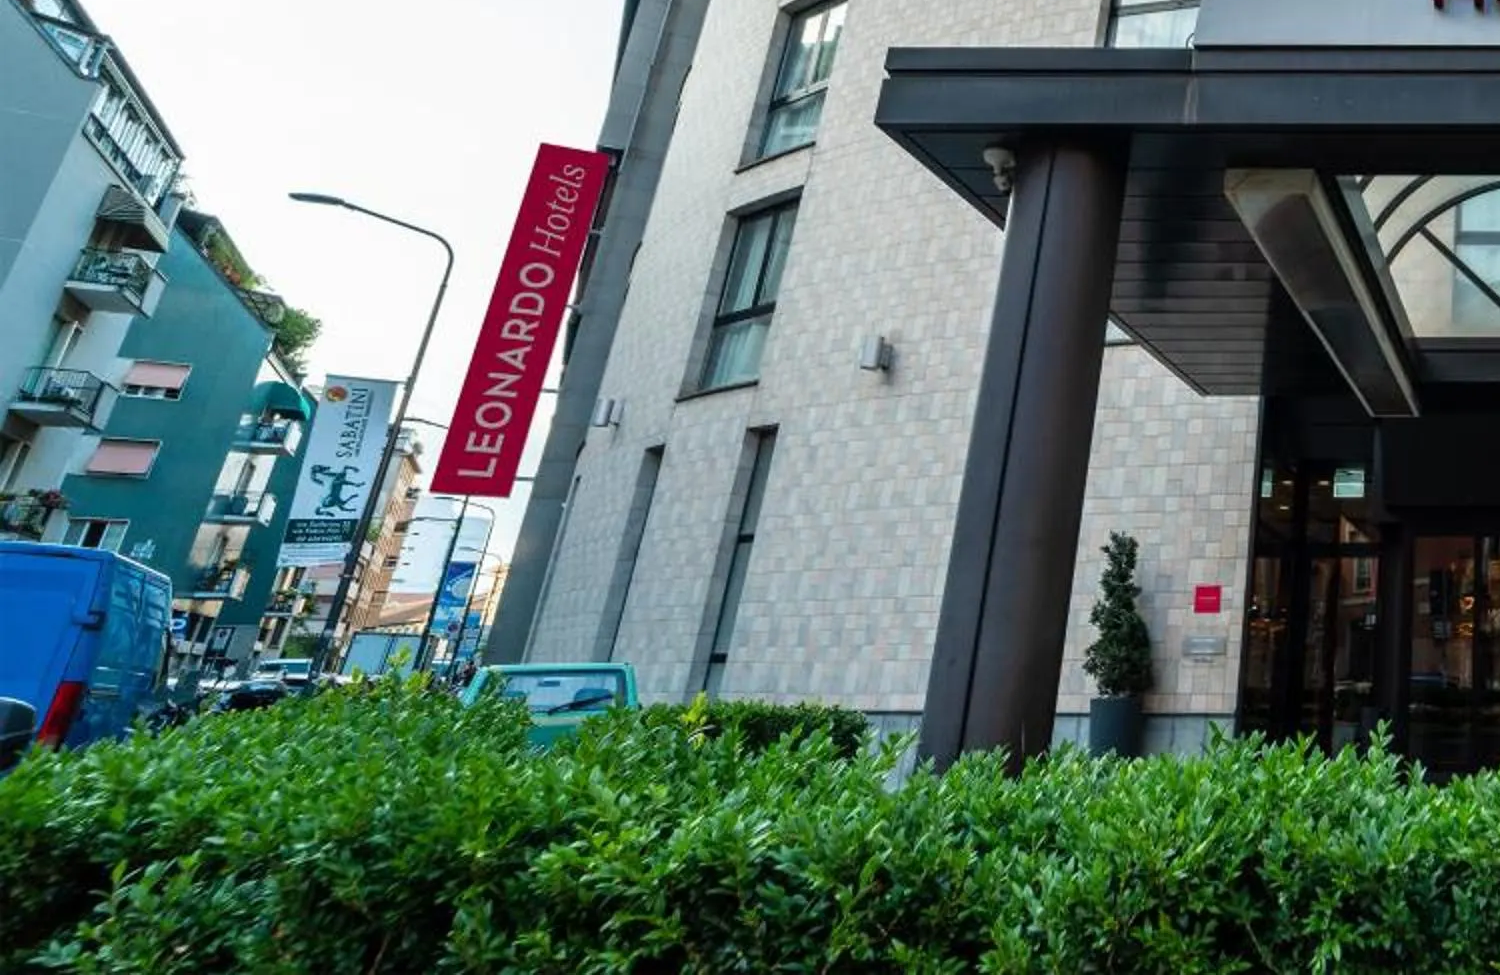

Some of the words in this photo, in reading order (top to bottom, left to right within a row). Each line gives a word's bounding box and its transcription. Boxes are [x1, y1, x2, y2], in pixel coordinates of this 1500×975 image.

[457, 262, 556, 479] LEONARDO
[529, 164, 585, 257] Hotels
[335, 388, 369, 458] SABATINI
